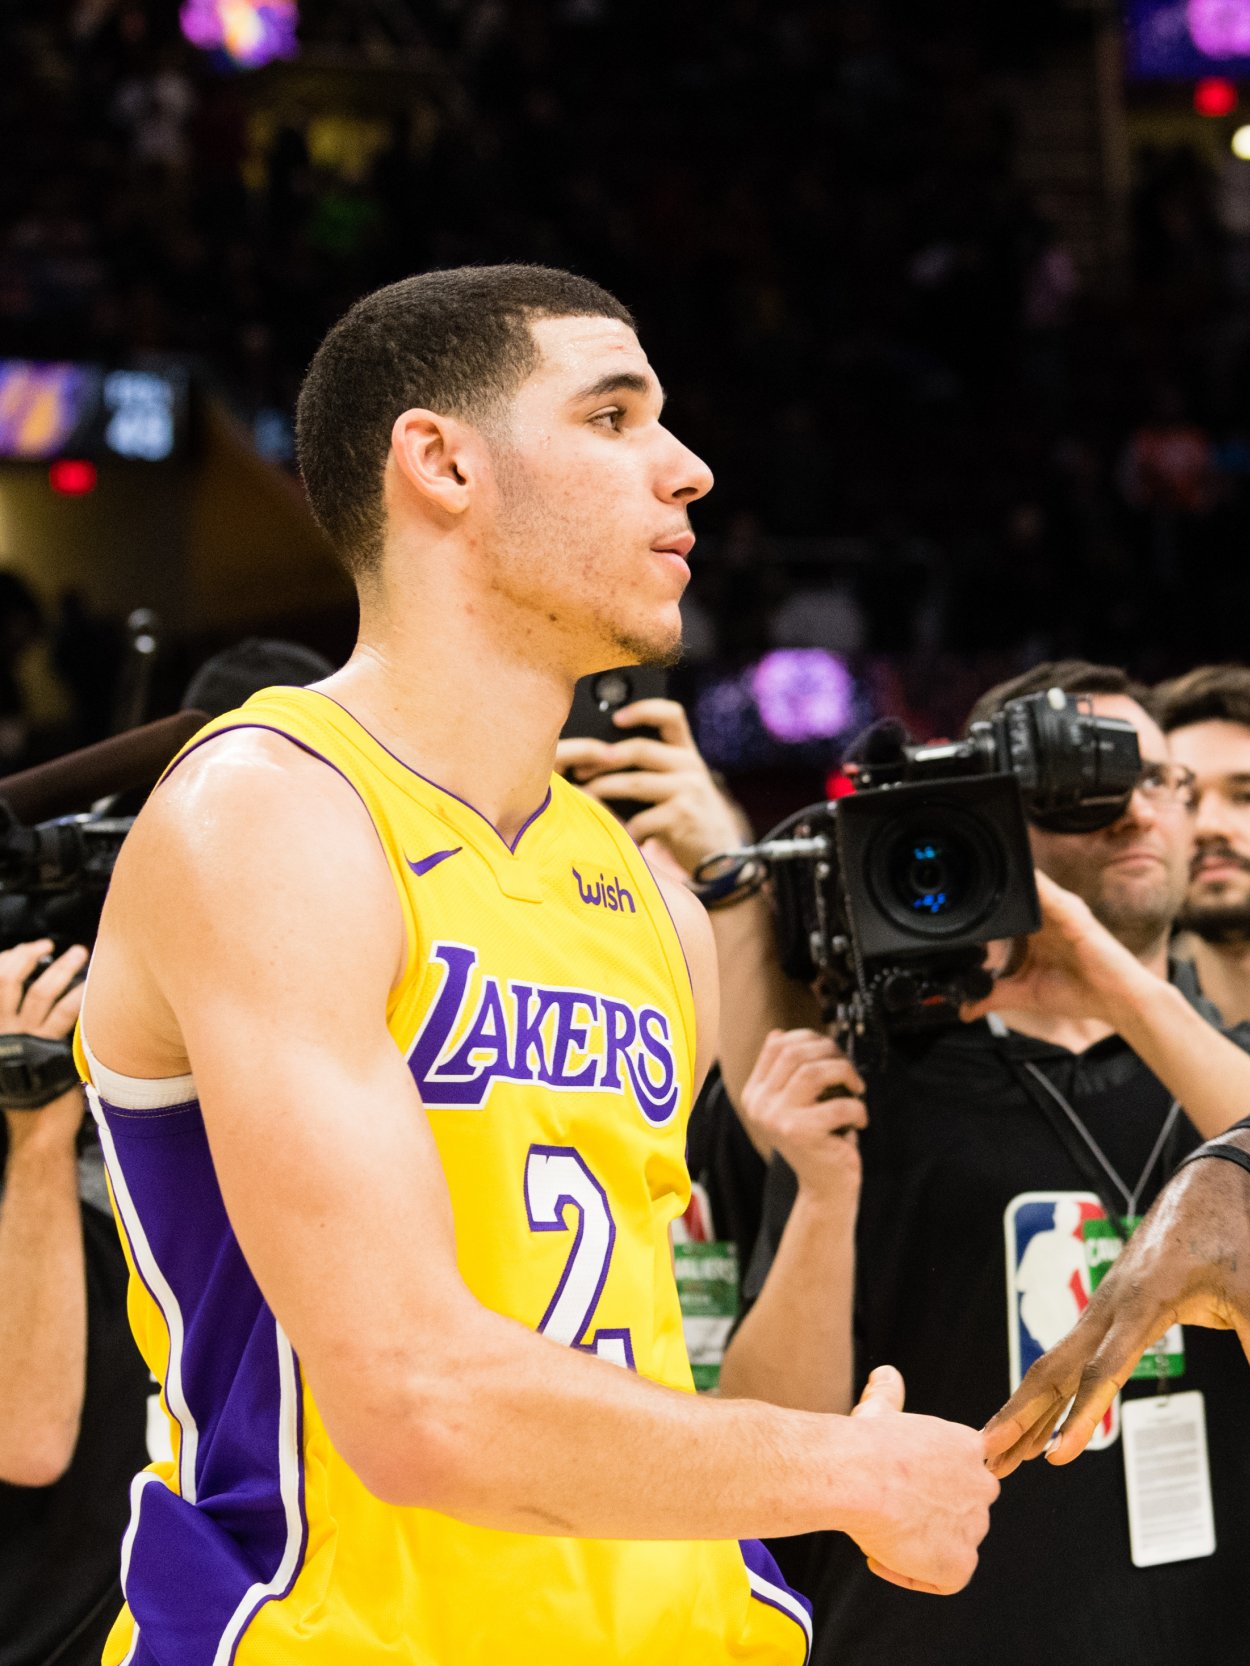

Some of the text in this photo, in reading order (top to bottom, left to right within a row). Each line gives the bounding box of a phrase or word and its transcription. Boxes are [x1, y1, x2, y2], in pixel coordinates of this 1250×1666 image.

[572, 866, 636, 913] wish
[407, 940, 681, 1128] LAKERS
[523, 1142, 638, 1376] 2
